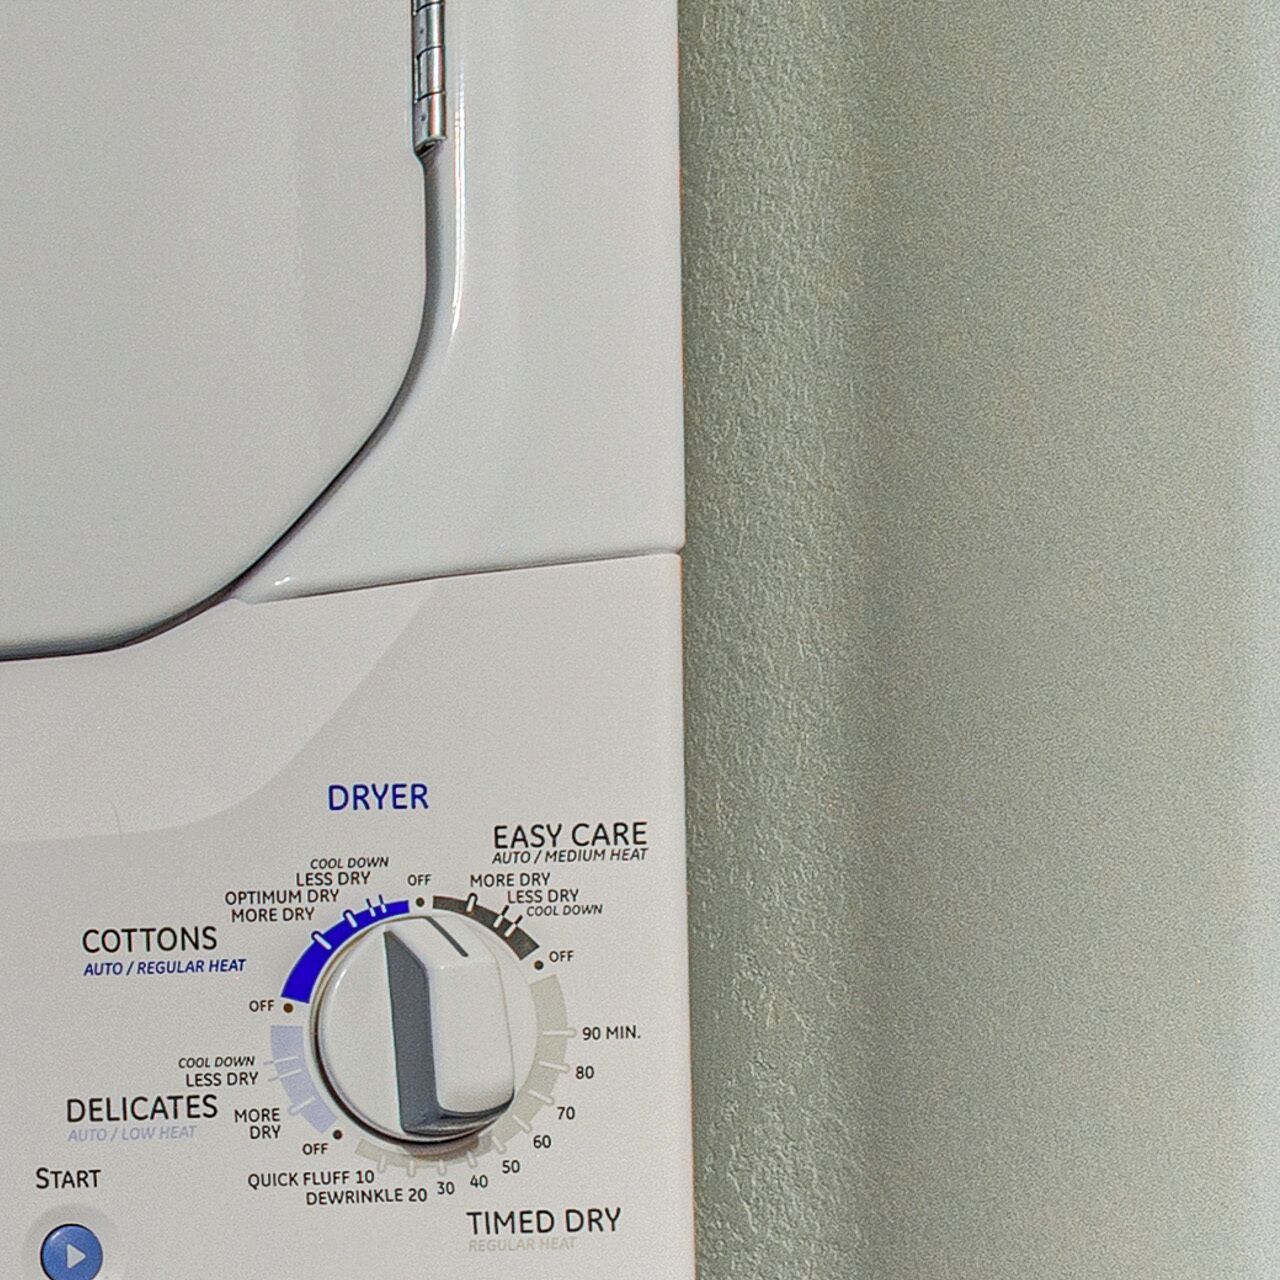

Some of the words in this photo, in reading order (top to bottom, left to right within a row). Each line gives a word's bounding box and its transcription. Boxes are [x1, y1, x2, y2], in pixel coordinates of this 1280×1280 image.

[328, 784, 428, 810] DRYER
[494, 824, 562, 849] EASY
[572, 822, 647, 846] CARE
[310, 858, 343, 870] COOL
[347, 857, 389, 868] DOWN
[492, 851, 531, 864] AUTO
[545, 849, 606, 862] MEDIUM
[610, 848, 648, 861] HEAT
[296, 872, 333, 887] LESS
[338, 871, 371, 886] DRY
[407, 874, 431, 886] OFF
[470, 873, 514, 888] MORE
[520, 872, 551, 887] DRY
[225, 890, 301, 905] OPTIMUM
[307, 889, 339, 903] DRY
[507, 889, 543, 904] LESS
[548, 888, 579, 903] DRY
[232, 908, 277, 923] MORE
[282, 907, 315, 922] DRY
[526, 905, 559, 917] COOL
[563, 904, 603, 916] DOWN
[82, 926, 217, 953] COTTONS
[549, 950, 573, 963] OFF
[84, 962, 123, 976] AUTO
[137, 960, 204, 975] REGULAR
[209, 959, 246, 972] HEAT
[249, 999, 274, 1012] OFF
[582, 1026, 601, 1041] 90
[606, 1025, 641, 1041] MIN.
[178, 1057, 210, 1069] COOL
[214, 1056, 255, 1067] DOWN
[186, 1072, 222, 1087] LESS
[227, 1072, 258, 1086] DRY
[575, 1066, 594, 1079] 80
[67, 1094, 218, 1123] DELICATES
[234, 1108, 280, 1122] MORE
[557, 1106, 575, 1120] 70
[67, 1128, 107, 1142] AUTO
[122, 1127, 155, 1140] LOW
[159, 1125, 197, 1139] HEAT
[250, 1125, 281, 1139] DRY
[302, 1143, 328, 1155] OFF
[533, 1135, 551, 1149] 60
[502, 1160, 520, 1174] 50
[248, 1173, 298, 1190] QUICK
[303, 1171, 349, 1185] FLUFF
[356, 1170, 374, 1184] 10
[437, 1181, 455, 1195] 30
[470, 1174, 488, 1188] 40
[306, 1188, 403, 1206] DEWRINKLE
[409, 1188, 427, 1202] 20
[466, 1210, 554, 1234] TIMED
[565, 1207, 621, 1232] DRY
[468, 1238, 534, 1252] REGULAR
[539, 1236, 577, 1250] HEAT
